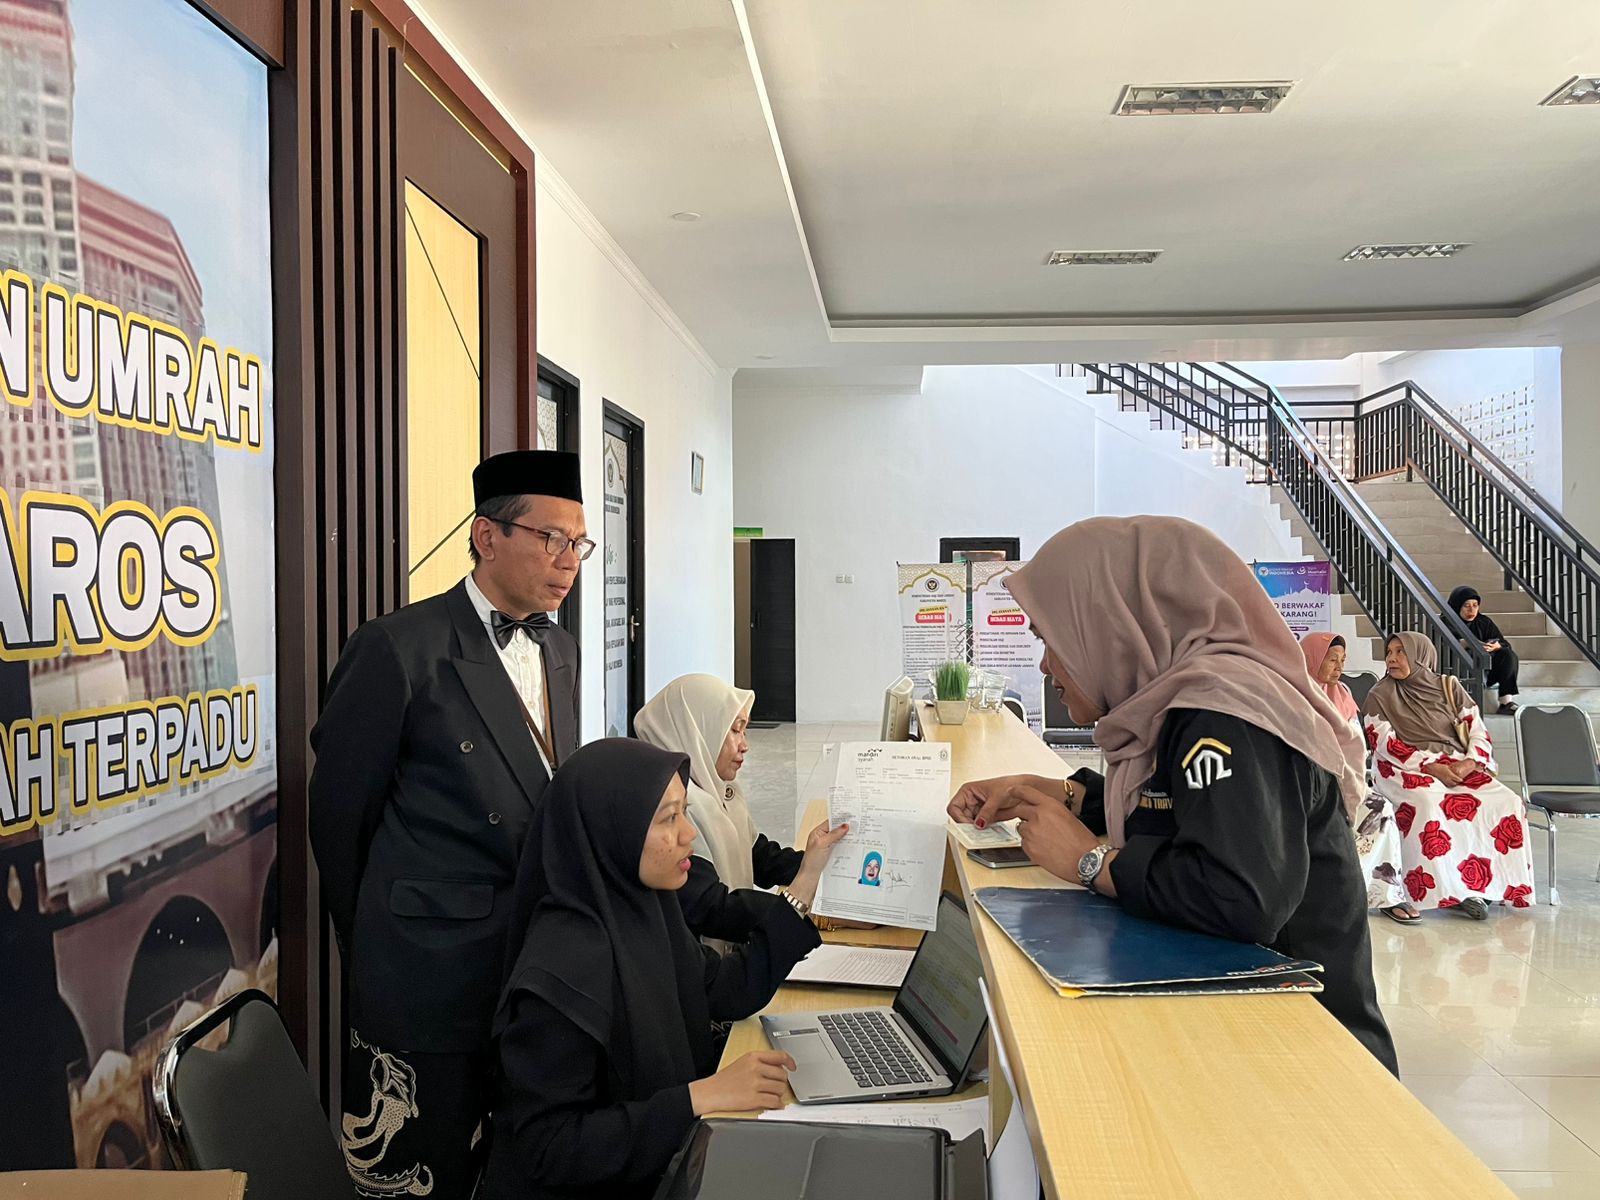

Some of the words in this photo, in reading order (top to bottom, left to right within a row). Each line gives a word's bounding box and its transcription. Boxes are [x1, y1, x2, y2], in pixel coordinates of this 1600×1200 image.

[44, 288, 261, 448] UMRAH
[1280, 610, 1317, 618] KARANG!
[61, 688, 256, 808] TERPADU
